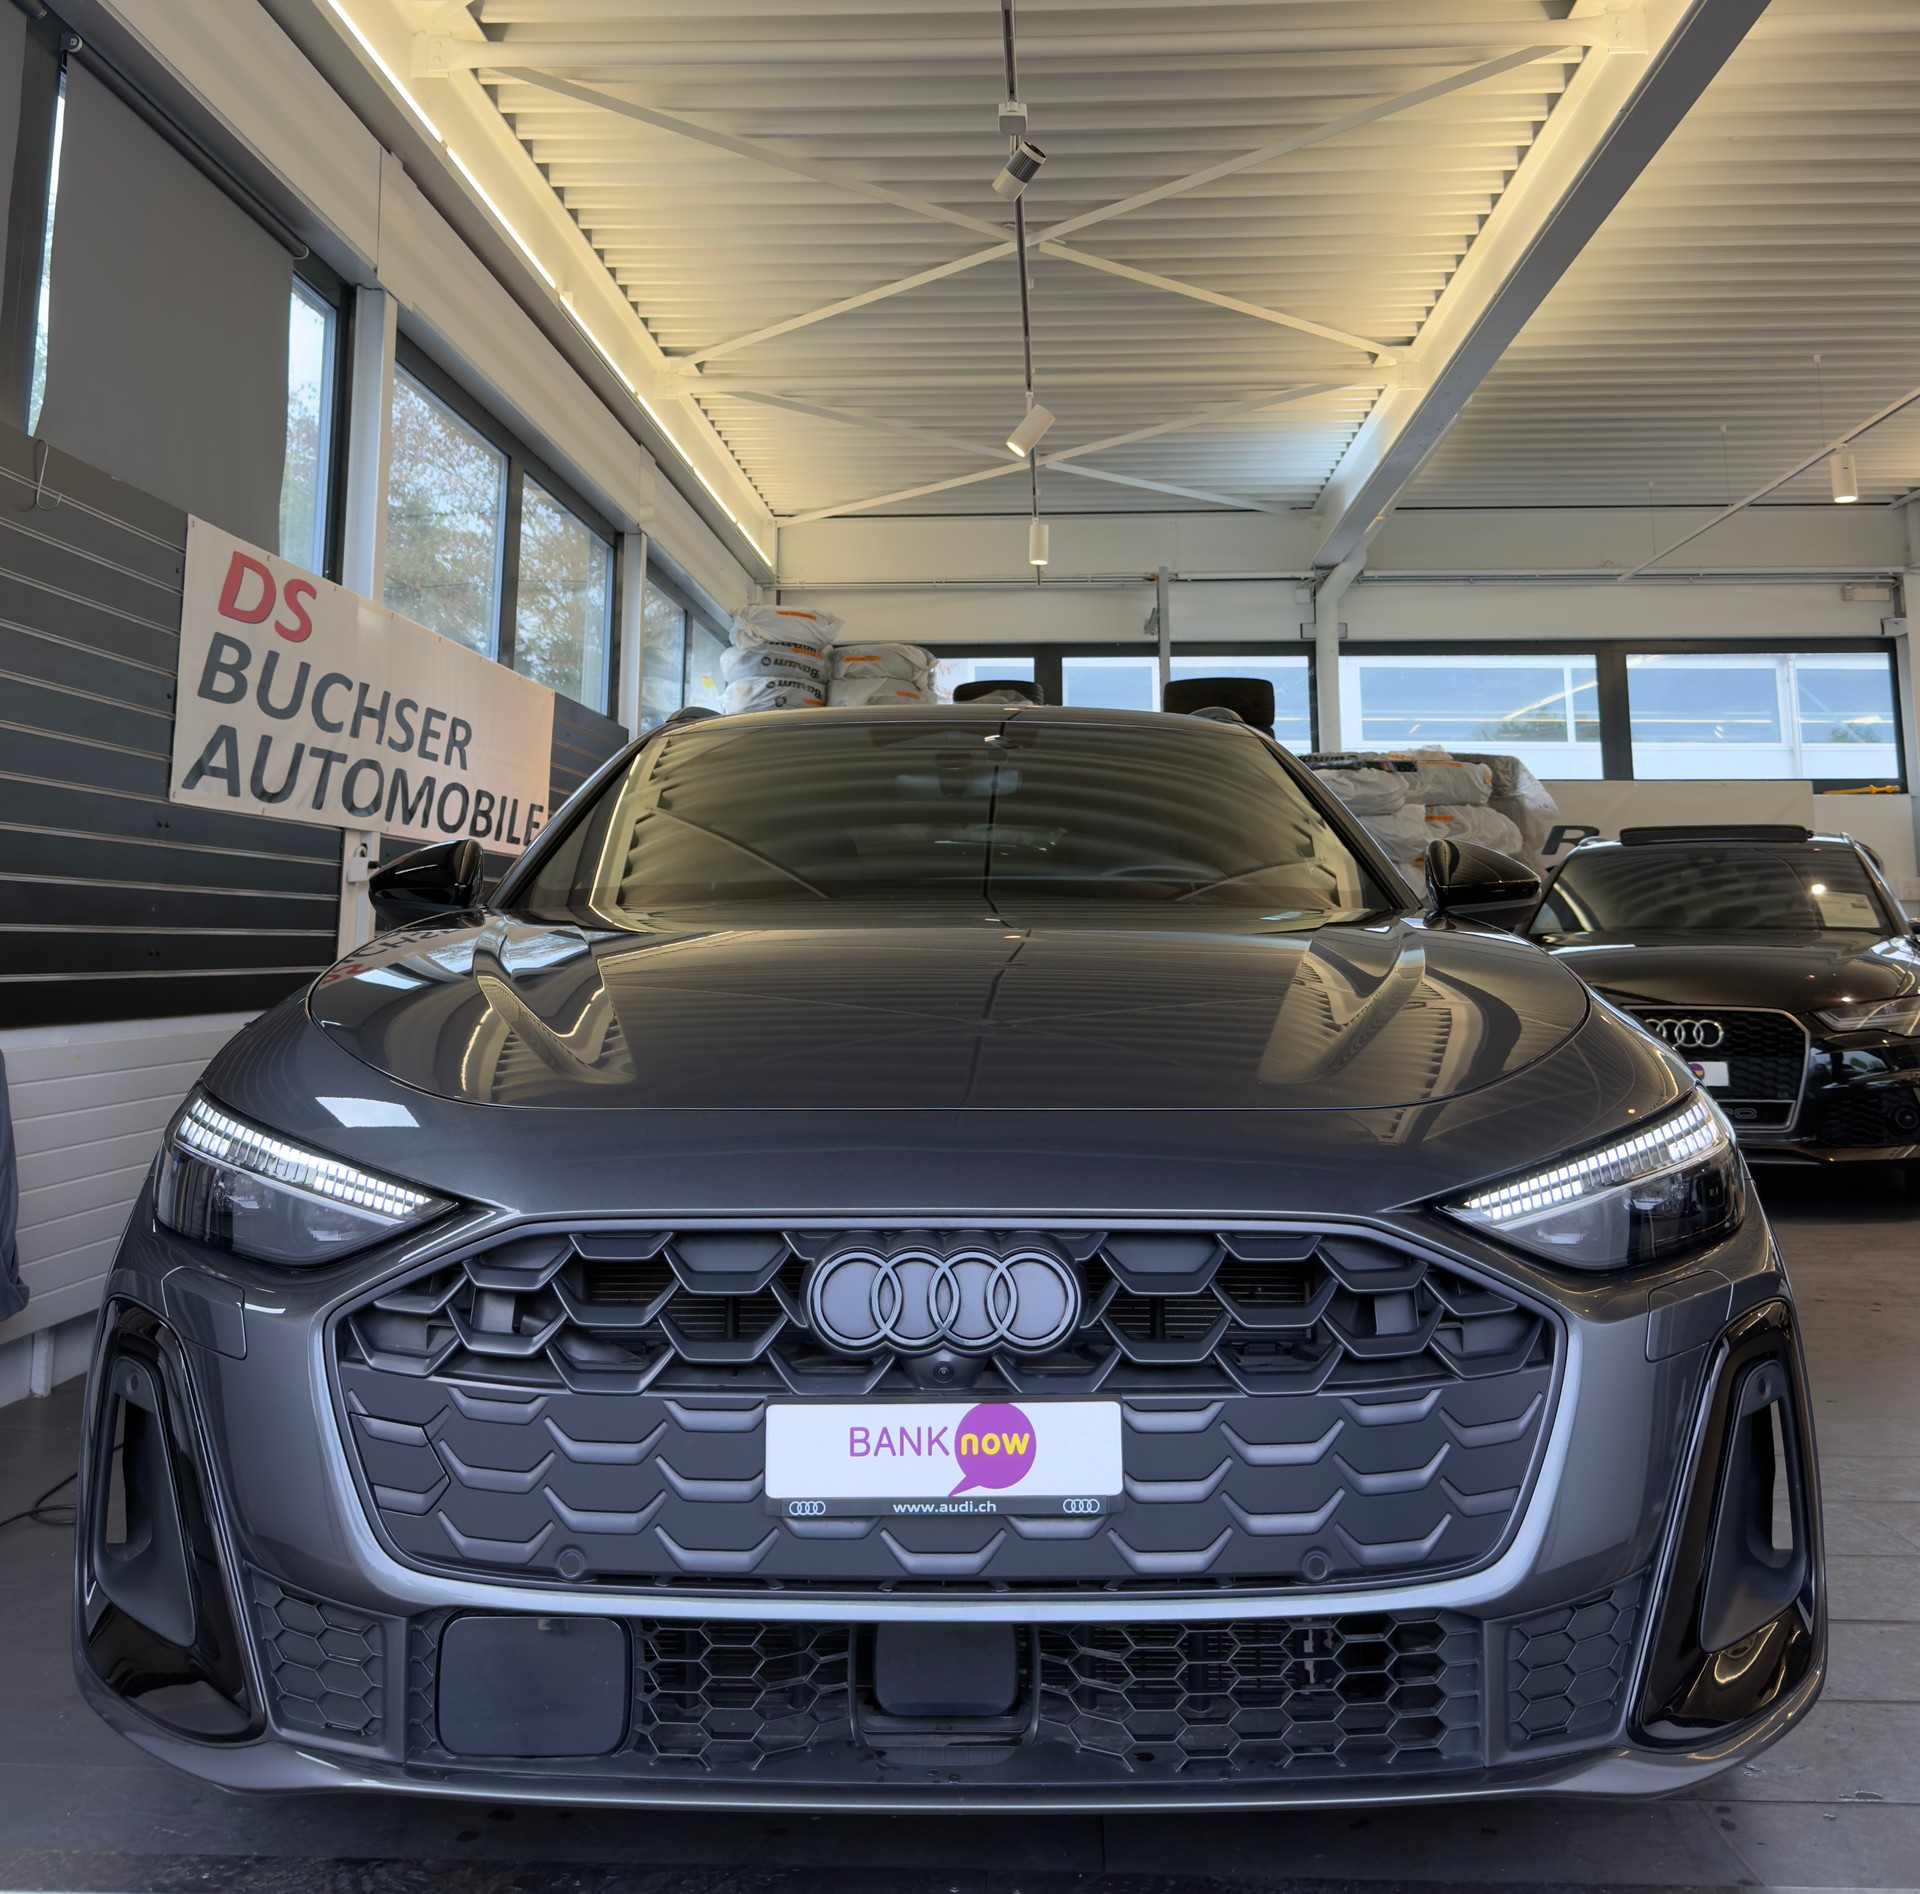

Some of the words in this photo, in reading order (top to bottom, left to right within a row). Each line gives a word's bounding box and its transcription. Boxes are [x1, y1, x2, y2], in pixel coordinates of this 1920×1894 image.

[217, 549, 318, 643] DS
[197, 631, 473, 771] BUCHSER
[181, 724, 544, 847] AUTOMOBILE
[849, 1426, 950, 1457] BANK
[960, 1433, 1030, 1455] now
[893, 1500, 997, 1513] www.audi.ch
